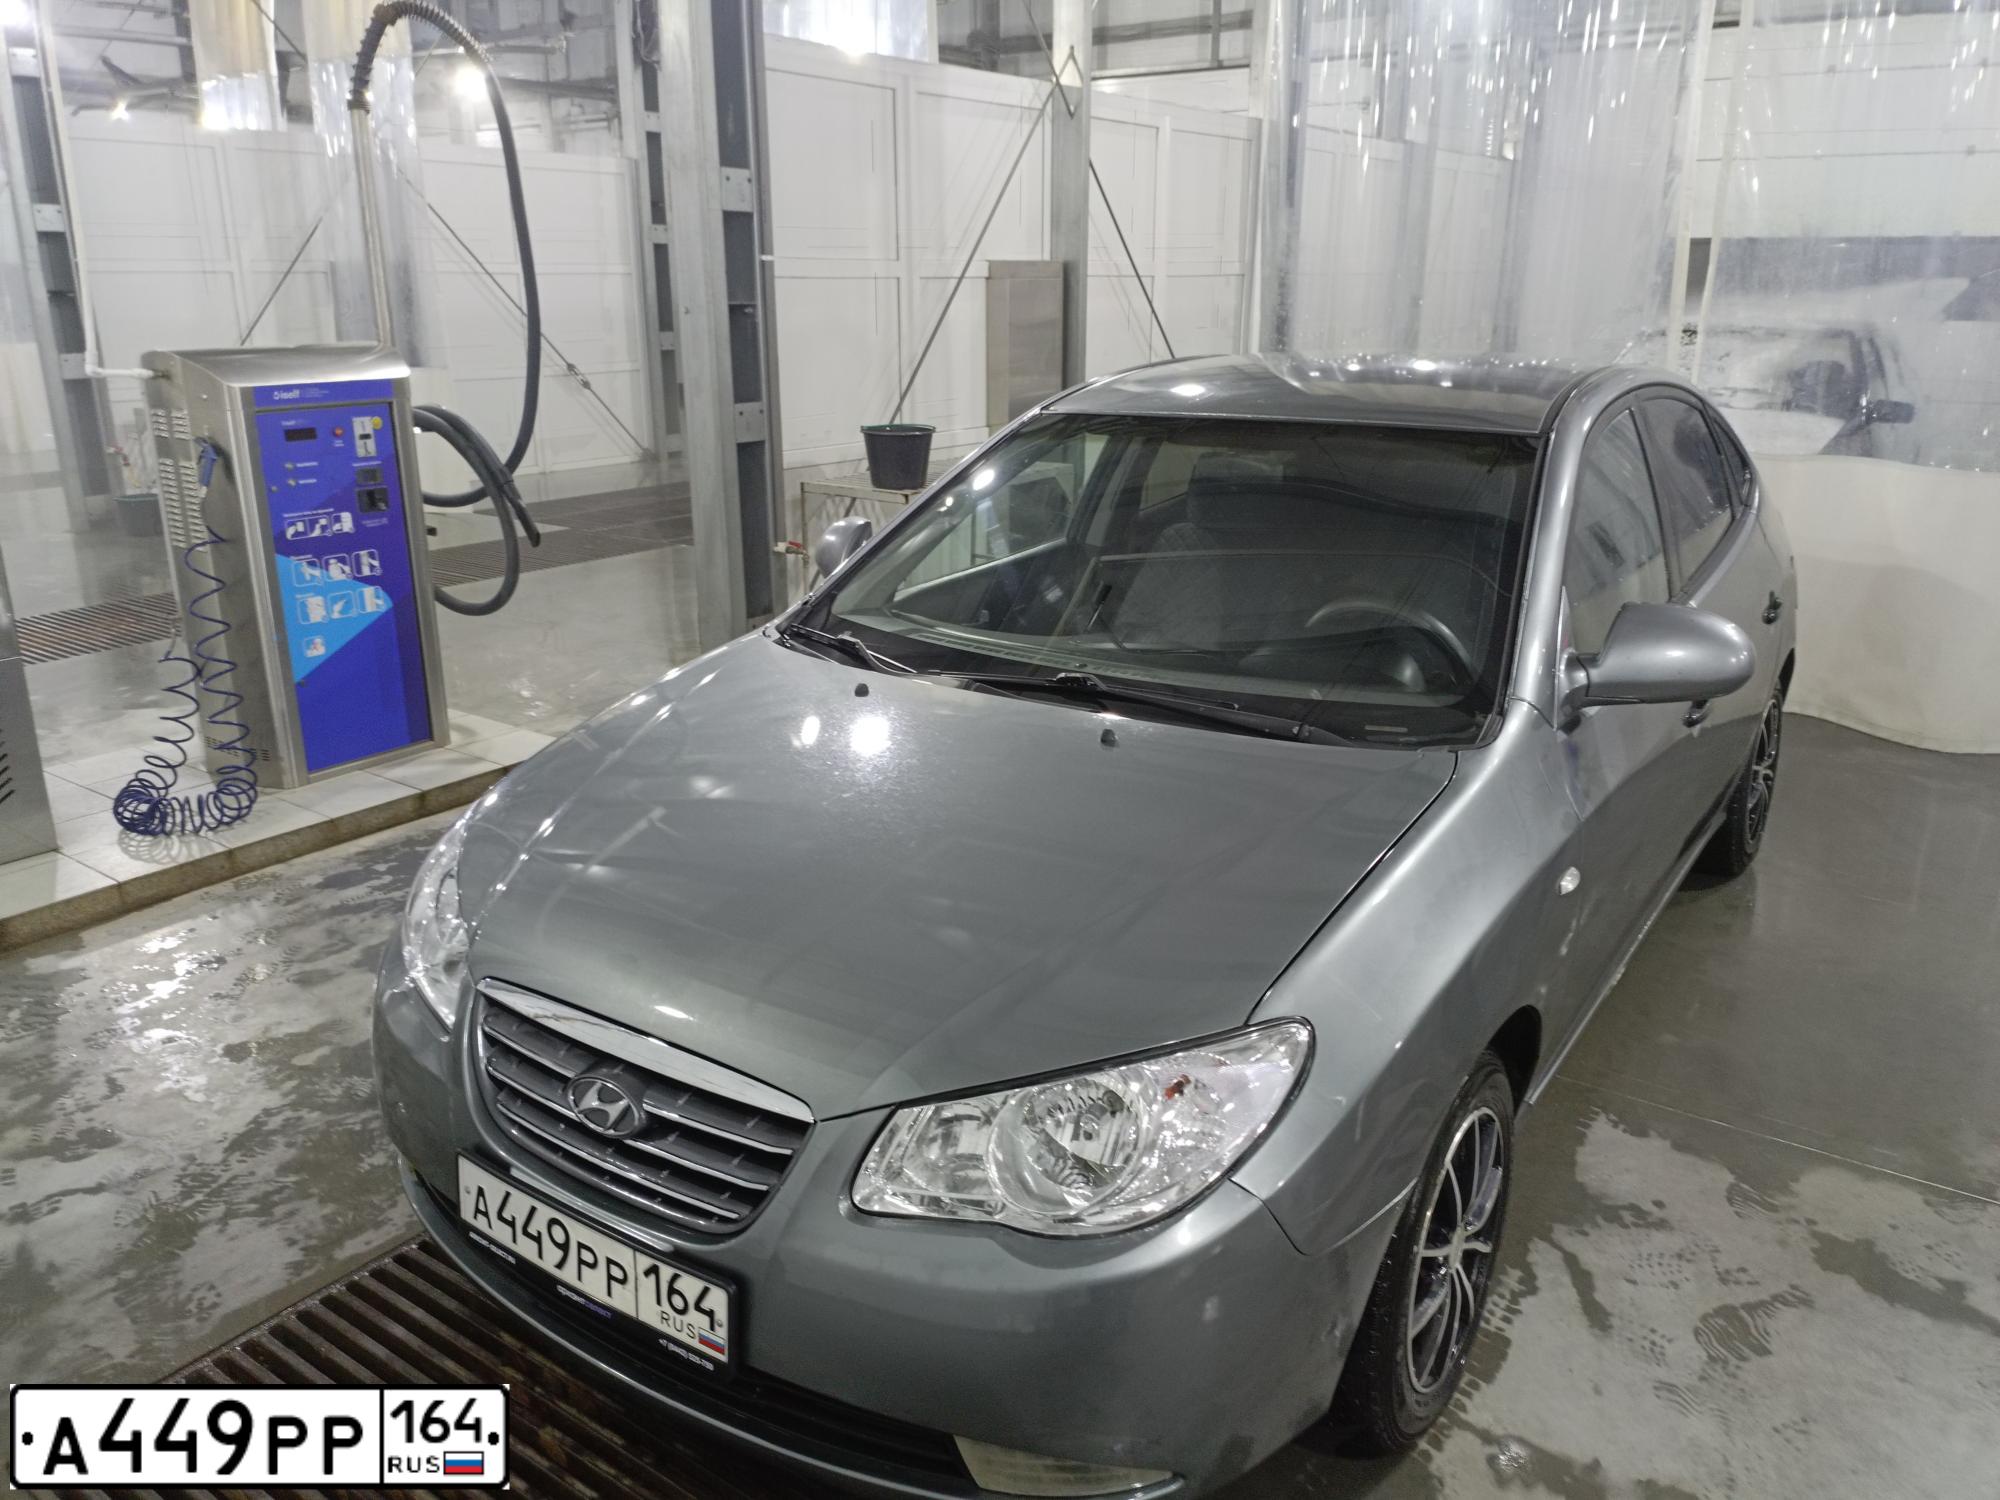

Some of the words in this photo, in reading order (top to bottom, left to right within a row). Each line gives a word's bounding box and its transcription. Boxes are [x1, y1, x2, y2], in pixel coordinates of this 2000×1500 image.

[473, 1185, 628, 1298] A449PP
[643, 1263, 716, 1332] 164
[659, 1310, 698, 1339] RUS
